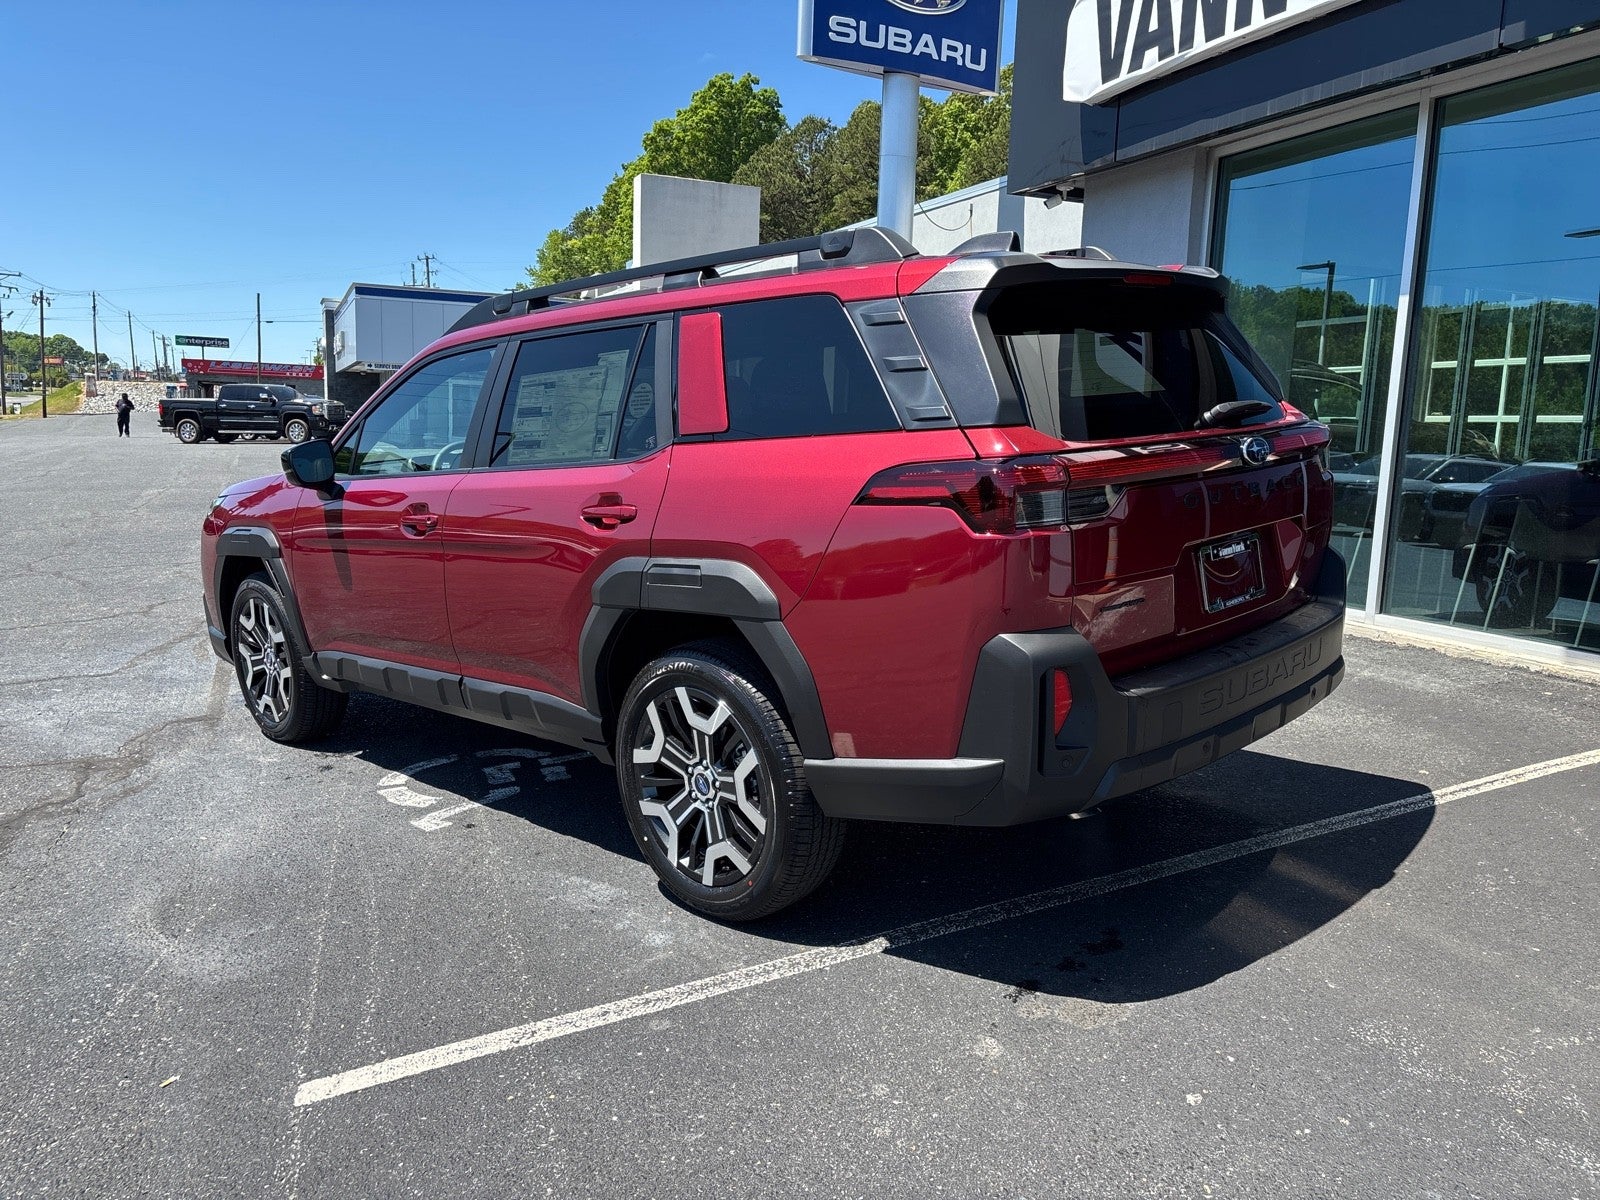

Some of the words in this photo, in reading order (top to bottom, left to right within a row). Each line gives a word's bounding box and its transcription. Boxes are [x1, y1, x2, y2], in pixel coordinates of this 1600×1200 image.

[828, 15, 987, 72] SUBARU
[1096, 0, 1289, 85] VA
[178, 337, 229, 346] enterprise
[643, 661, 700, 680] IDGESTONE
[1200, 637, 1323, 715] SUBARU
